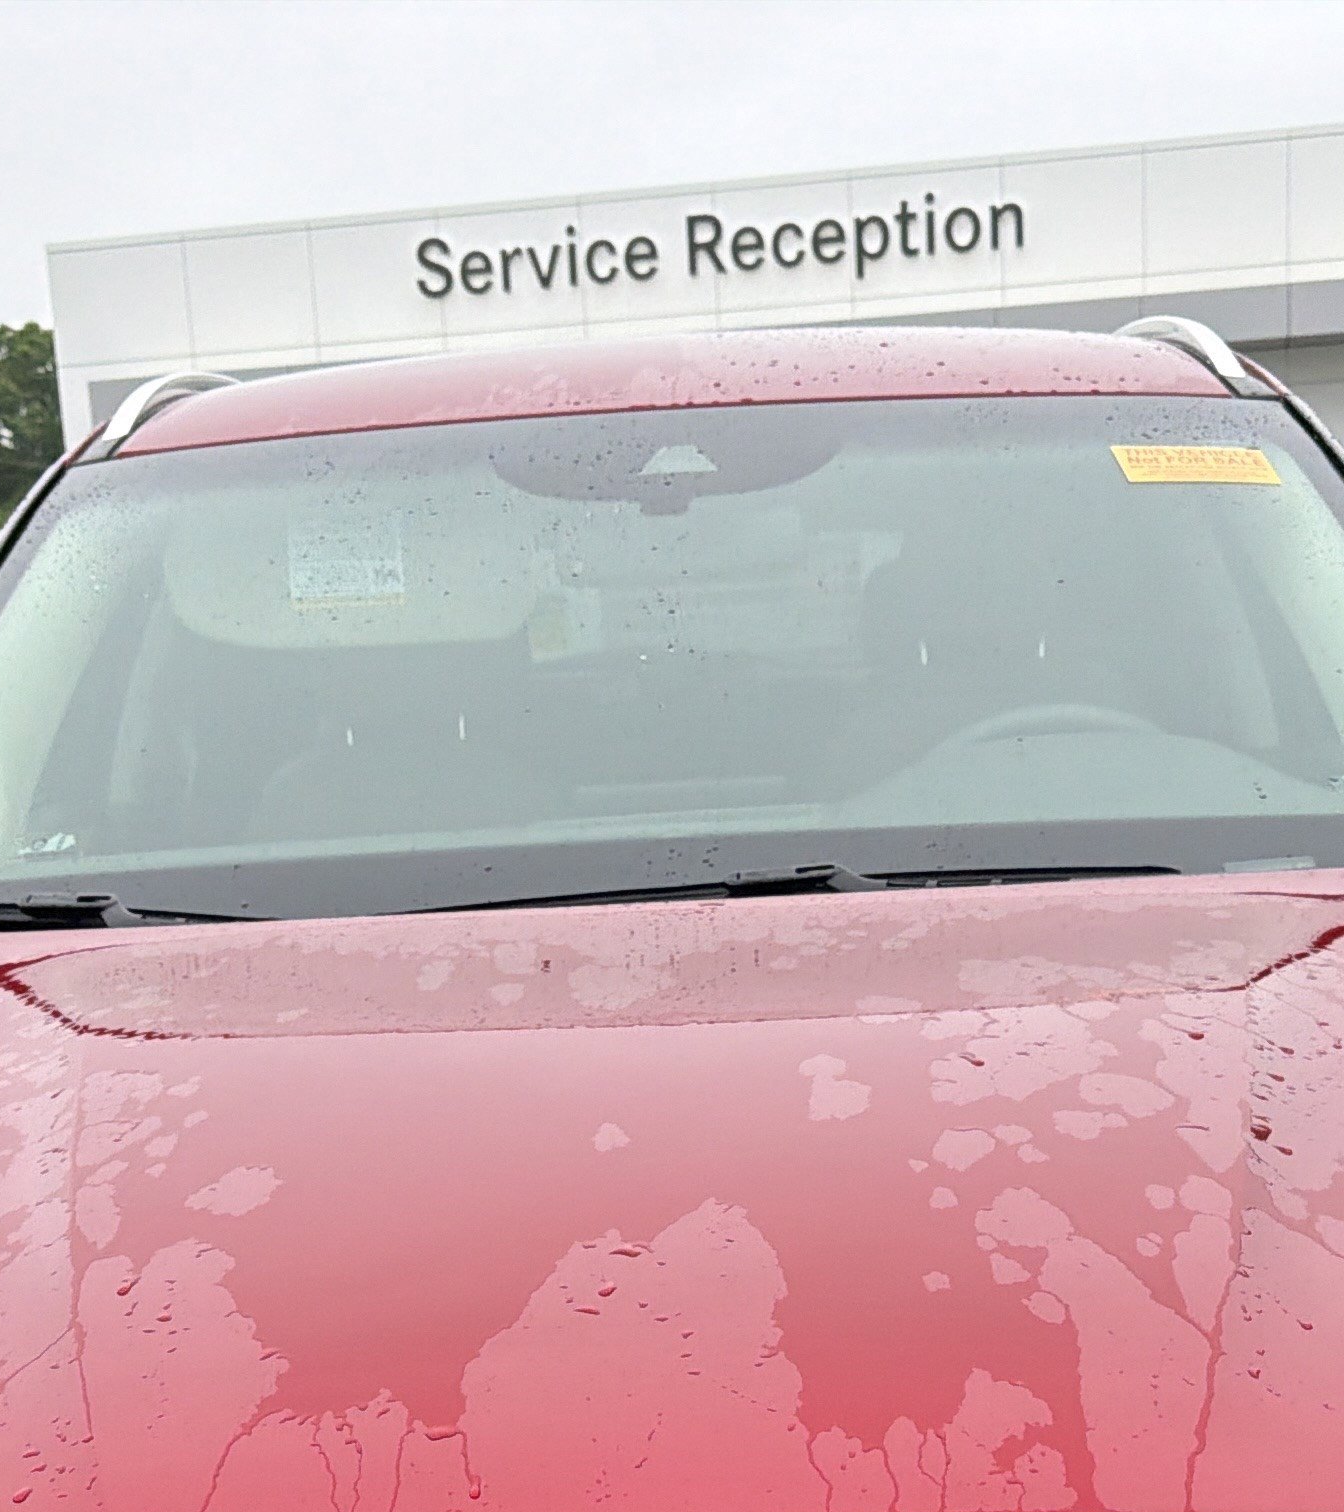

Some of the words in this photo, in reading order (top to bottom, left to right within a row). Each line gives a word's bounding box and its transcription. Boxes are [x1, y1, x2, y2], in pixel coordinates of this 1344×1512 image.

[416, 225, 658, 299] Service
[685, 192, 1025, 279] Reception
[1165, 456, 1207, 465] FOR
